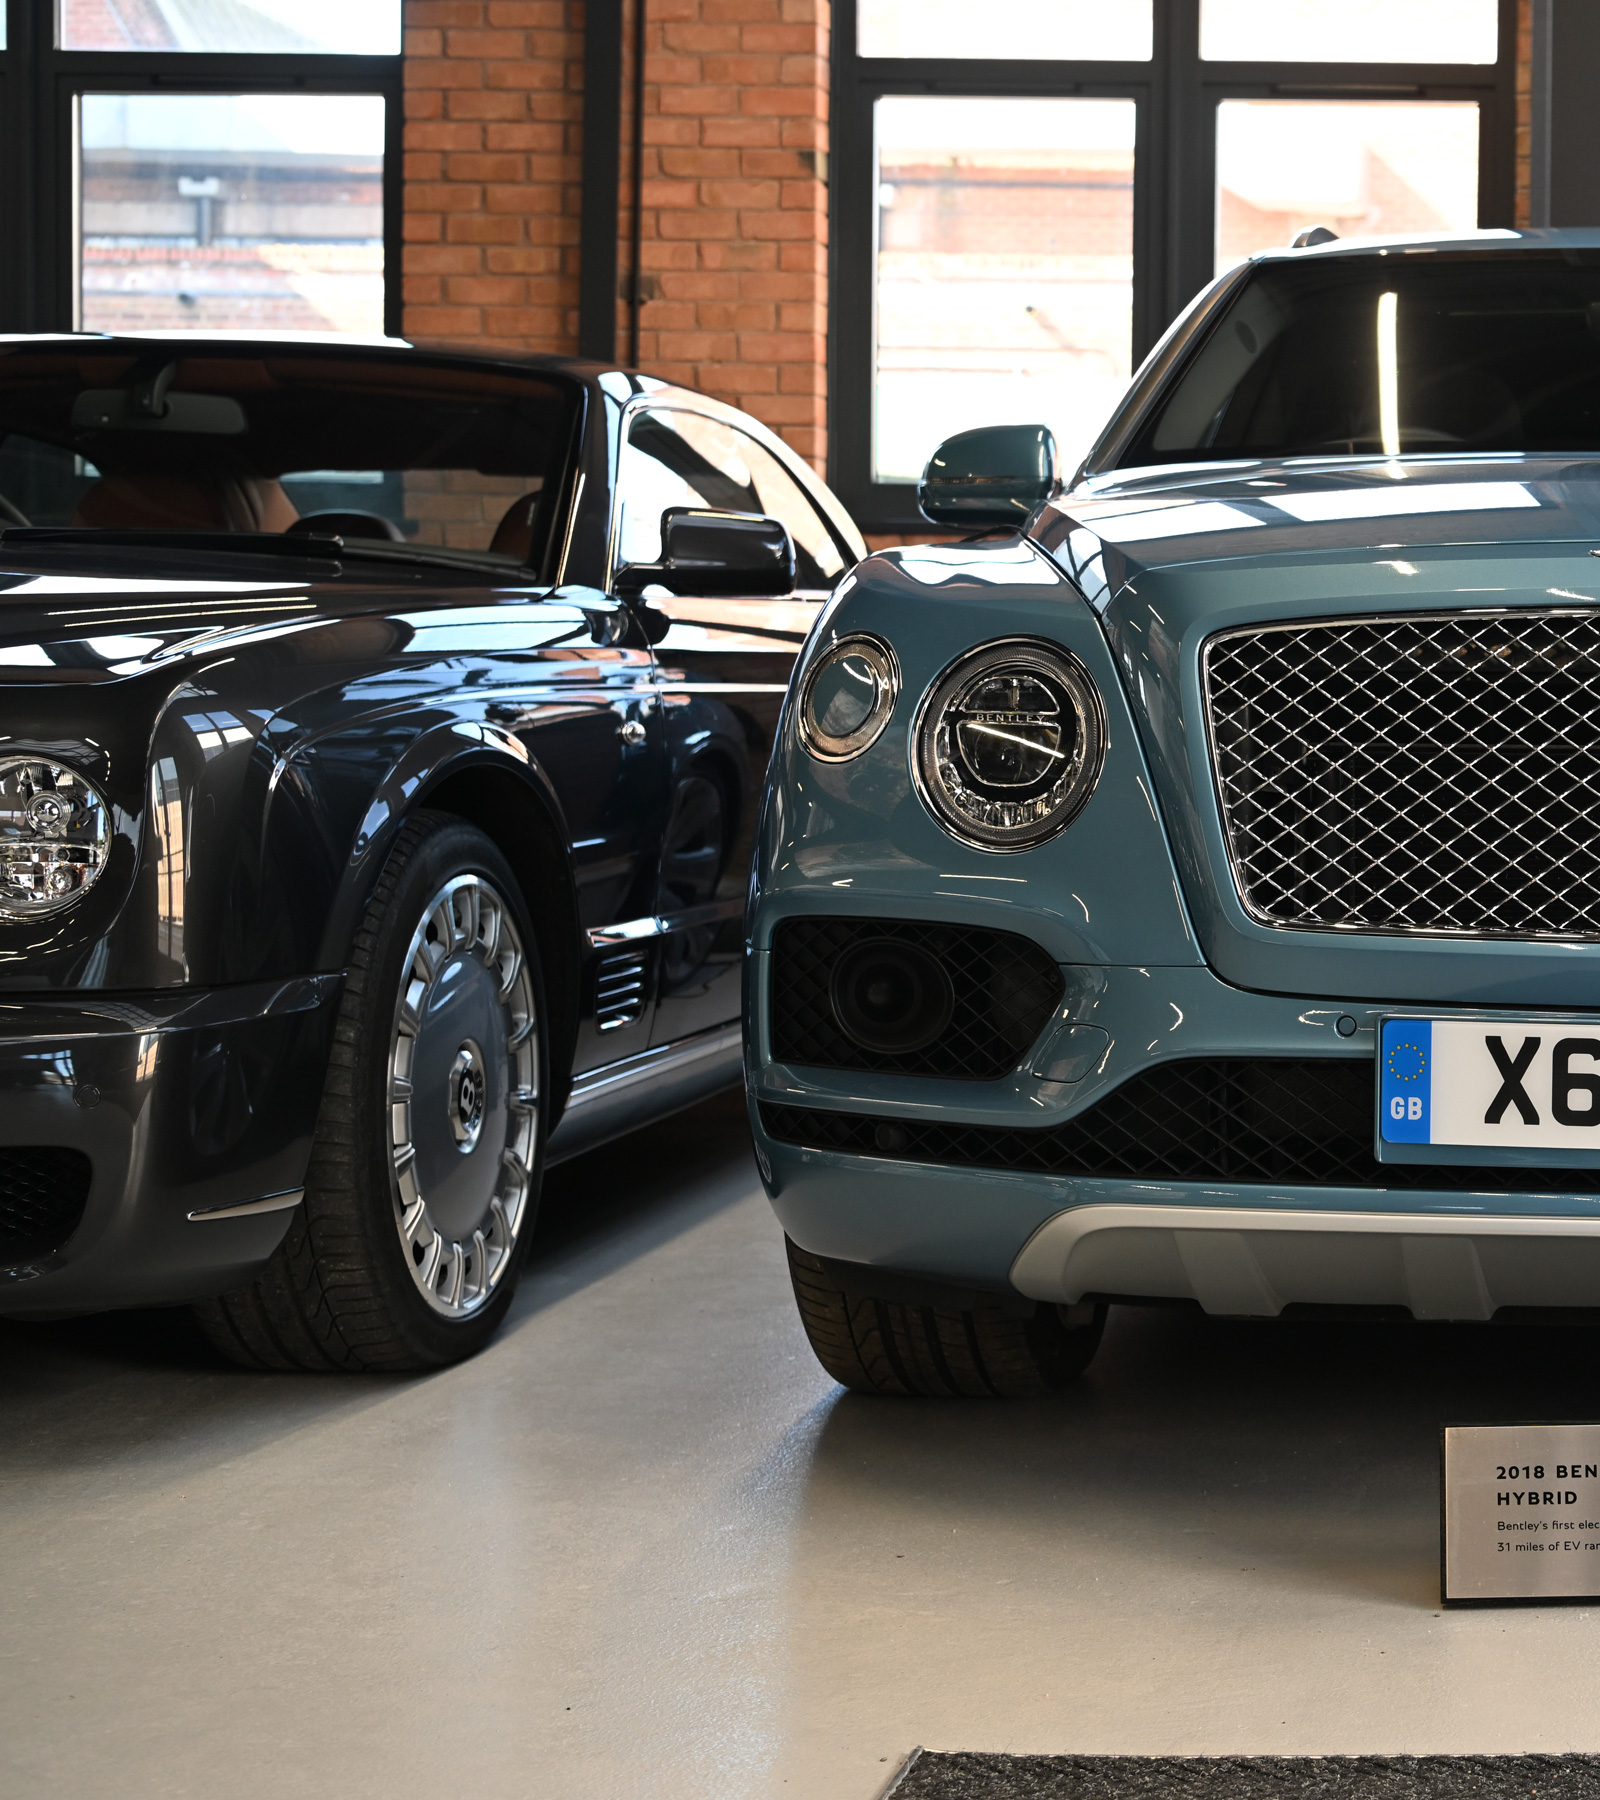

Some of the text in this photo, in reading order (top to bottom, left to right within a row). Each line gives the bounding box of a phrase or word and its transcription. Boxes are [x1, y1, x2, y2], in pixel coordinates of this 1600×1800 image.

[976, 713, 1045, 722] BENTLEY
[1390, 1096, 1423, 1120] GB
[1496, 1465, 1545, 1480] 2018
[1497, 1491, 1578, 1506] HYBRID
[1497, 1521, 1548, 1532] Bentley's
[1552, 1520, 1575, 1530] first
[1497, 1542, 1511, 1552] 31
[1515, 1541, 1545, 1552] miles
[1548, 1541, 1560, 1551] of
[1564, 1541, 1581, 1551] EV
